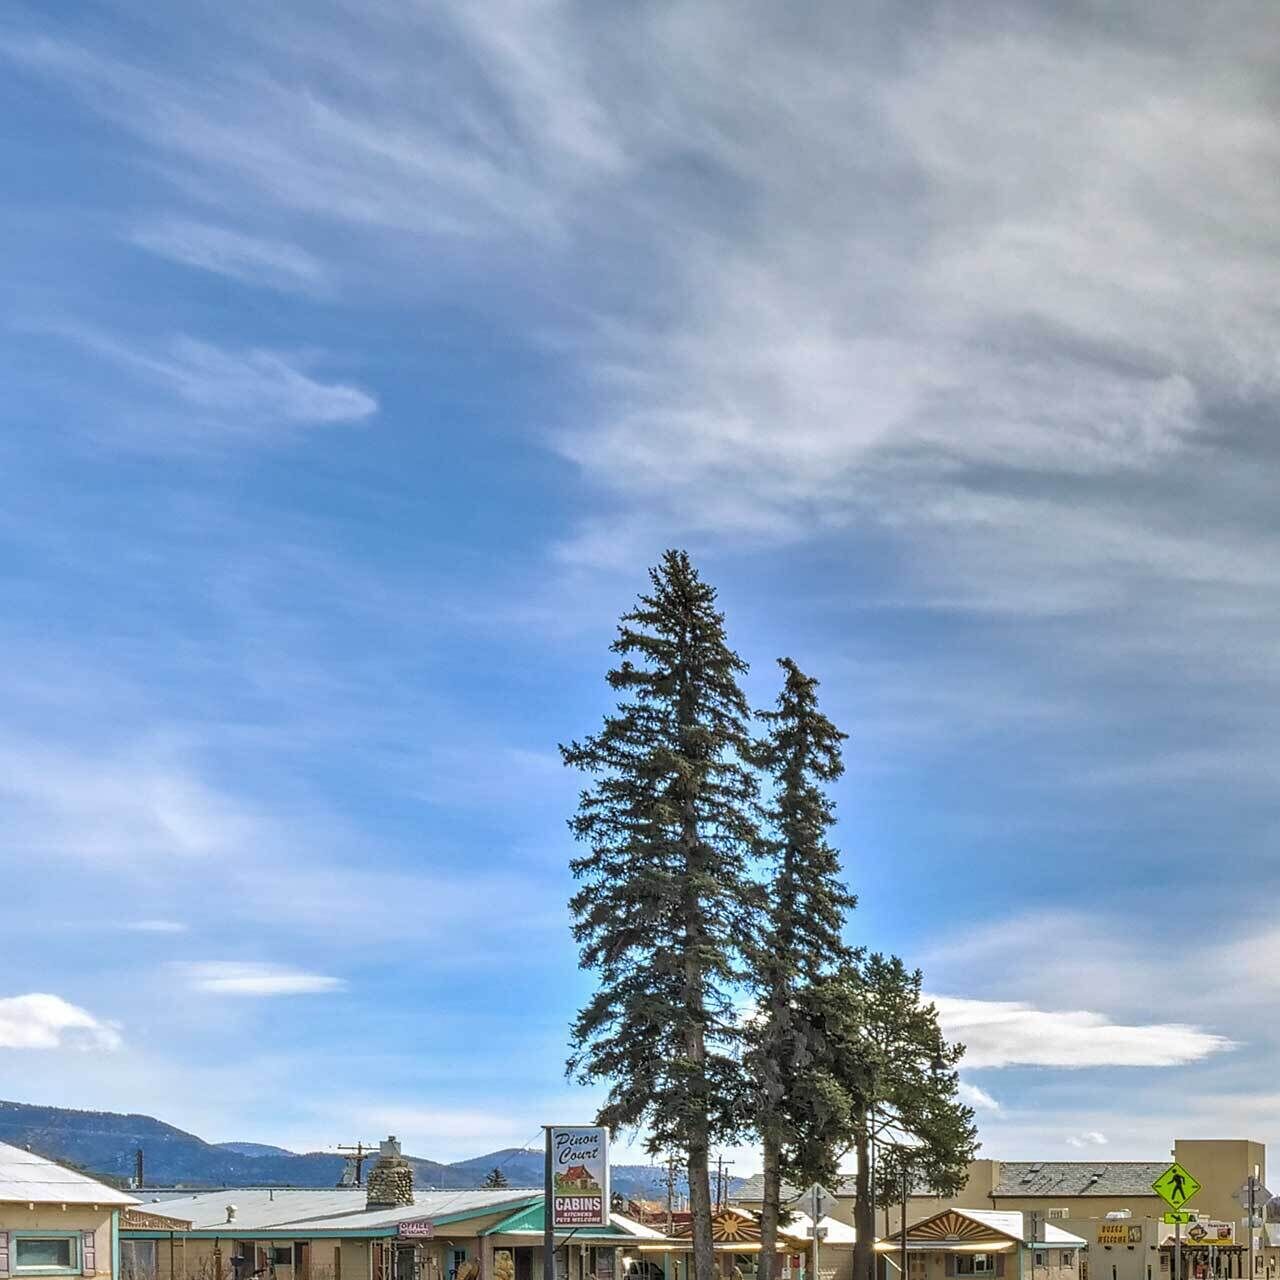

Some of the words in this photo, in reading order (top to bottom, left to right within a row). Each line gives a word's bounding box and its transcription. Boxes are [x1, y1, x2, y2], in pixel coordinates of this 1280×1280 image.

[555, 1132, 598, 1149] Pinon
[559, 1147, 598, 1165] Court
[555, 1197, 601, 1211] CABINS
